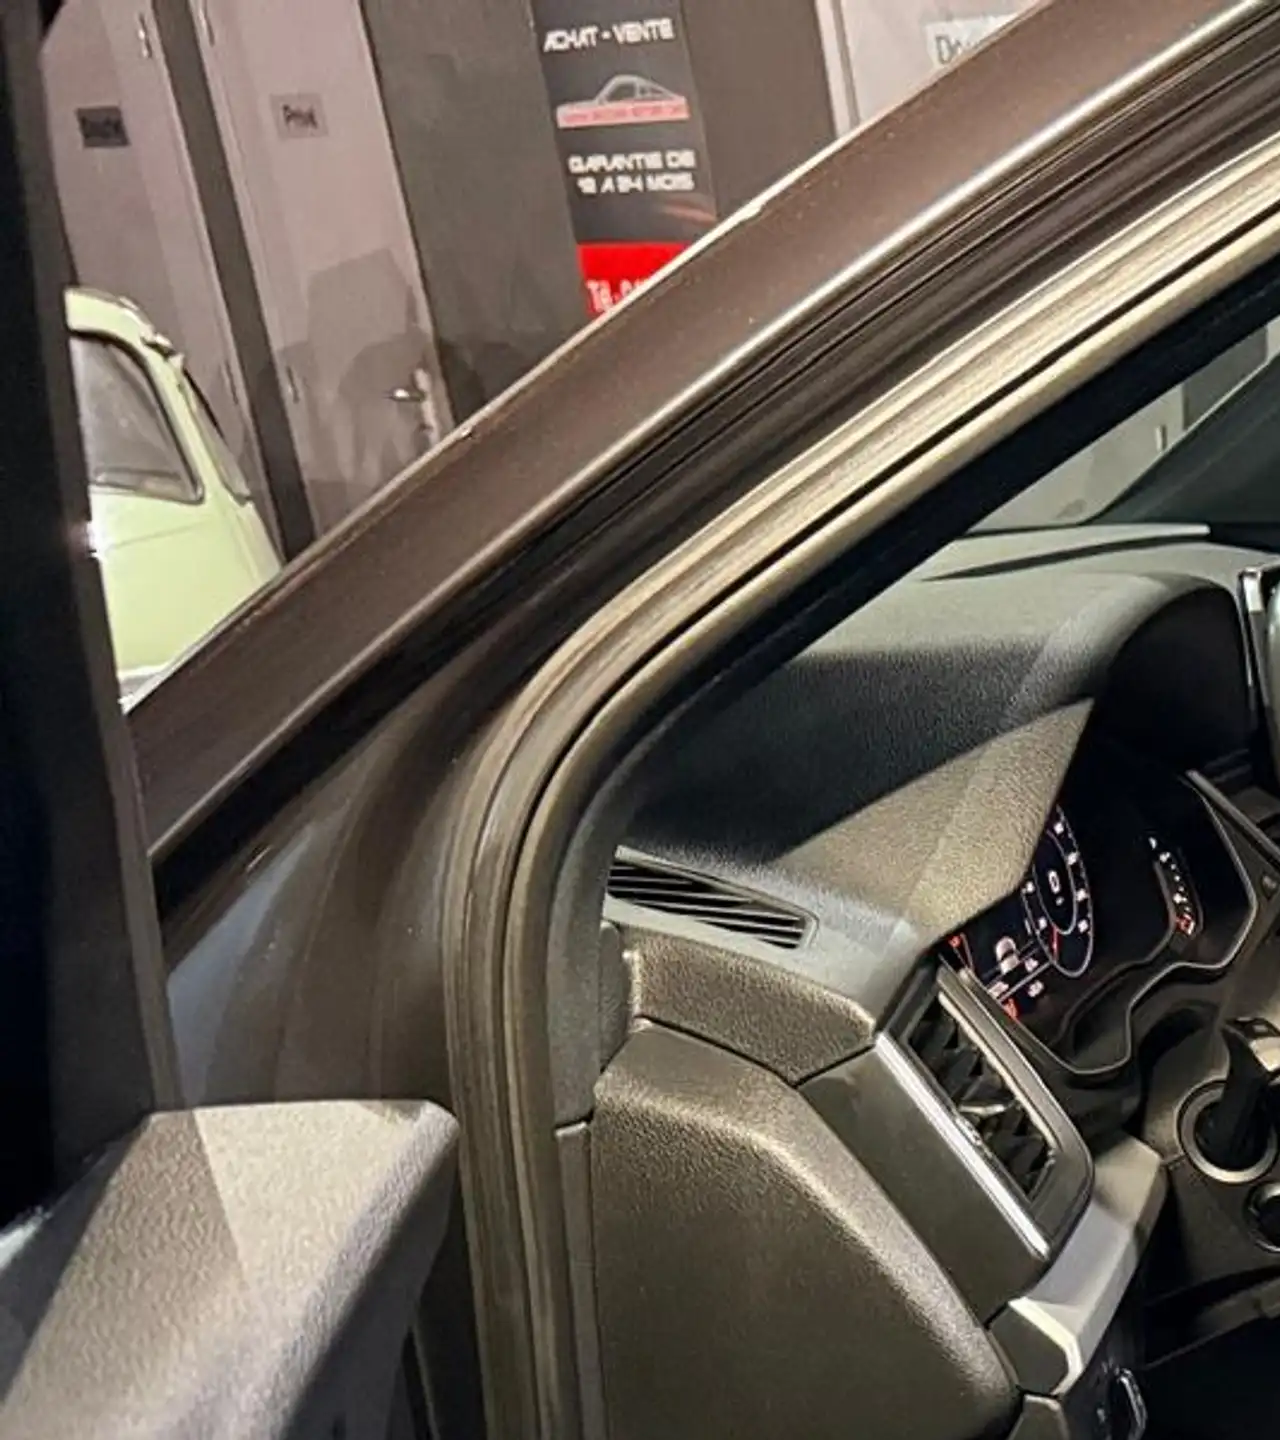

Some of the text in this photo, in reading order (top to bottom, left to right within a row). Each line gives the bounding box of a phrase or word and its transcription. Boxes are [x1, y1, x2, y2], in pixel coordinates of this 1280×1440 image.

[543, 26, 598, 52] ACHAT
[612, 18, 674, 44] VENTE
[568, 149, 696, 173] GARANTIE DE
[645, 171, 694, 191] MOIS
